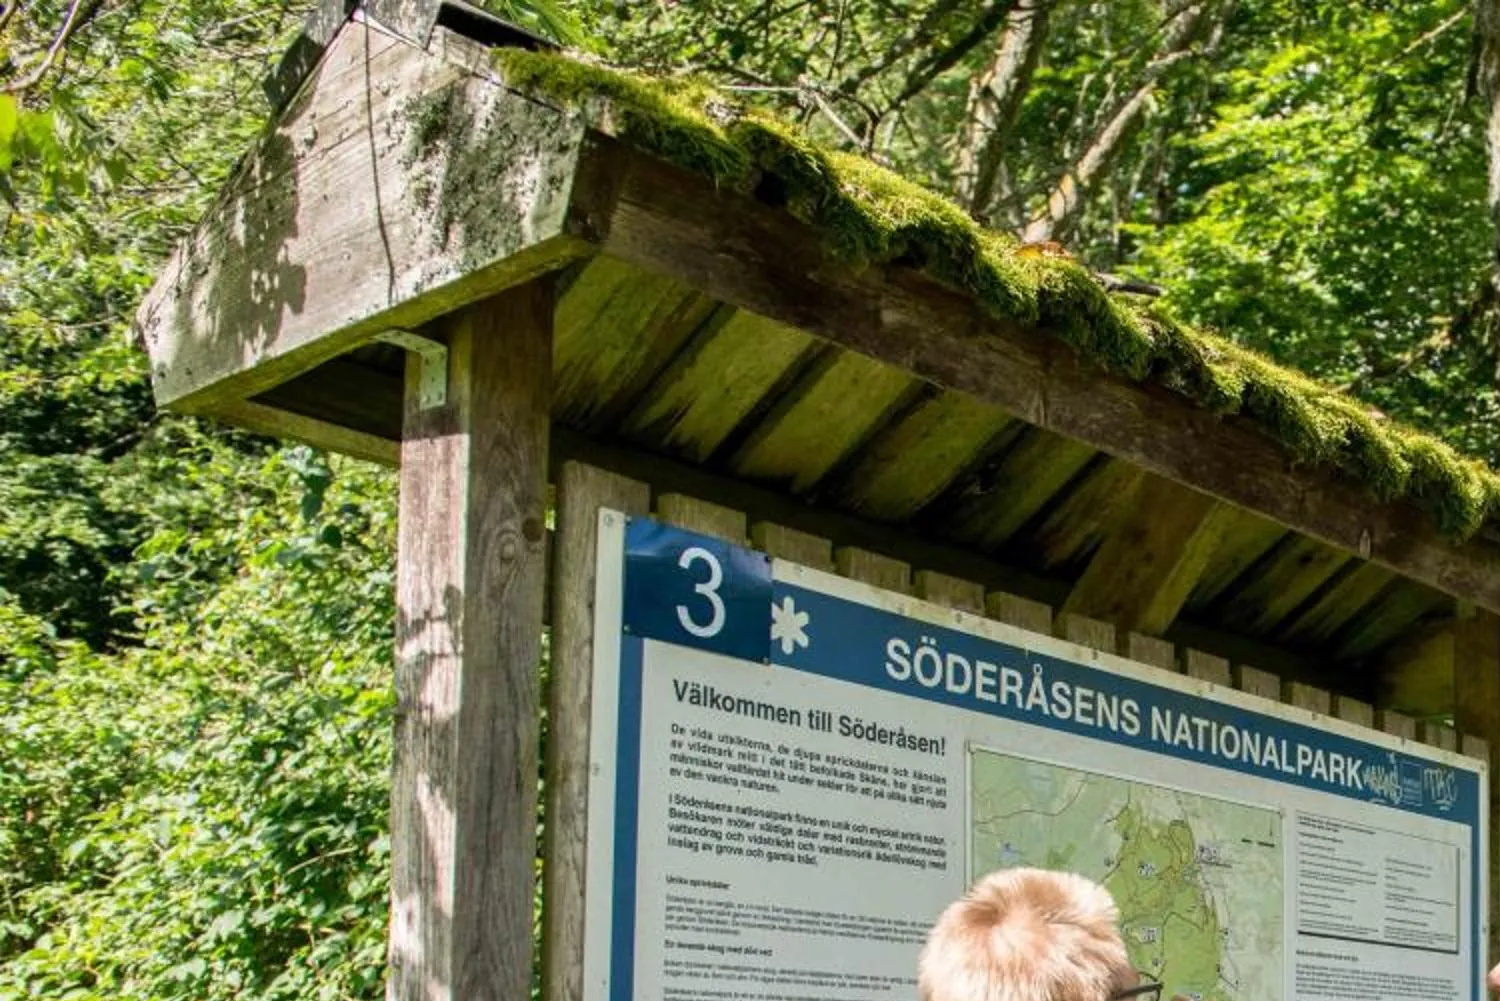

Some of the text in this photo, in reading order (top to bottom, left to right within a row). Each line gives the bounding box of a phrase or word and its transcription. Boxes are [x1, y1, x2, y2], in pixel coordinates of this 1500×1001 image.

[677, 547, 726, 638] 3
[673, 679, 946, 756] Välkommen till Söderåsen!
[885, 635, 1141, 736] SÖDERÅSENS
[1151, 705, 1365, 790] NATIONALPARK
[726, 832, 744, 842] och
[797, 841, 814, 851] och
